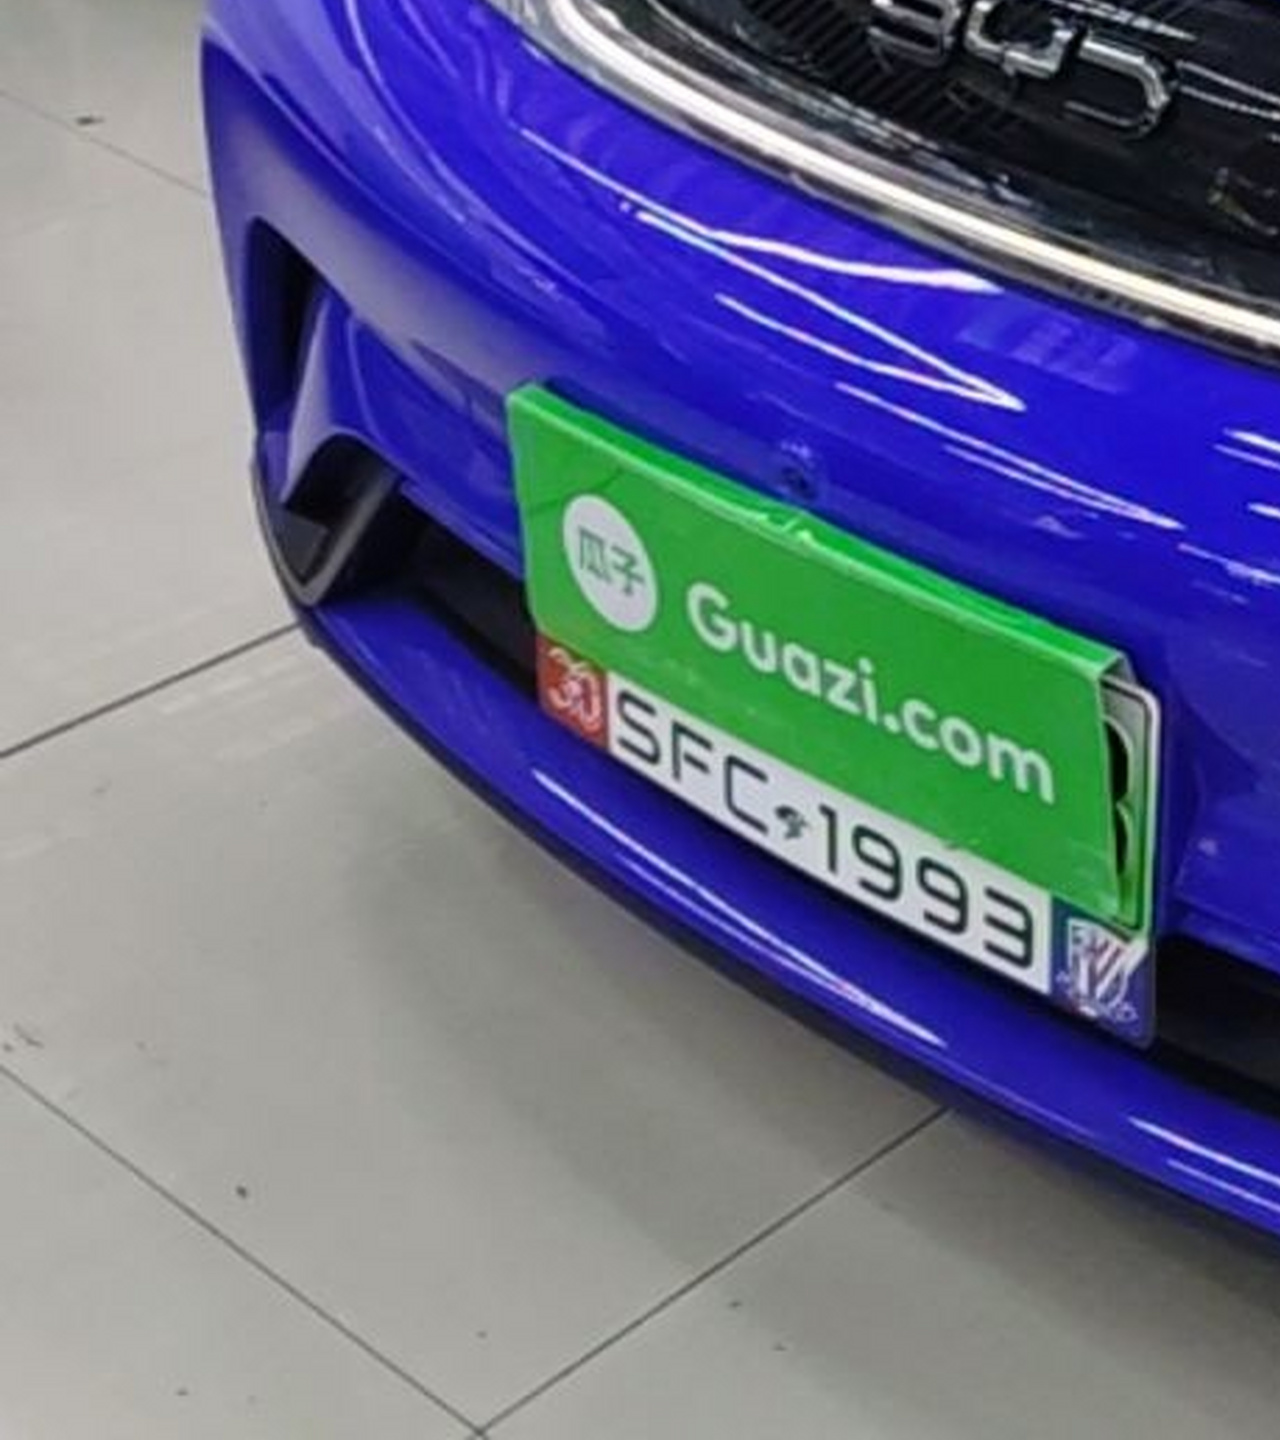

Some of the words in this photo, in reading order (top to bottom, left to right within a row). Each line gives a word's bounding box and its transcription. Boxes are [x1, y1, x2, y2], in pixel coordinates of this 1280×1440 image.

[578, 526, 647, 596] 瓜子
[685, 581, 1055, 806] Guazi.com
[616, 690, 771, 836] SFC
[817, 803, 1035, 970] 1993
